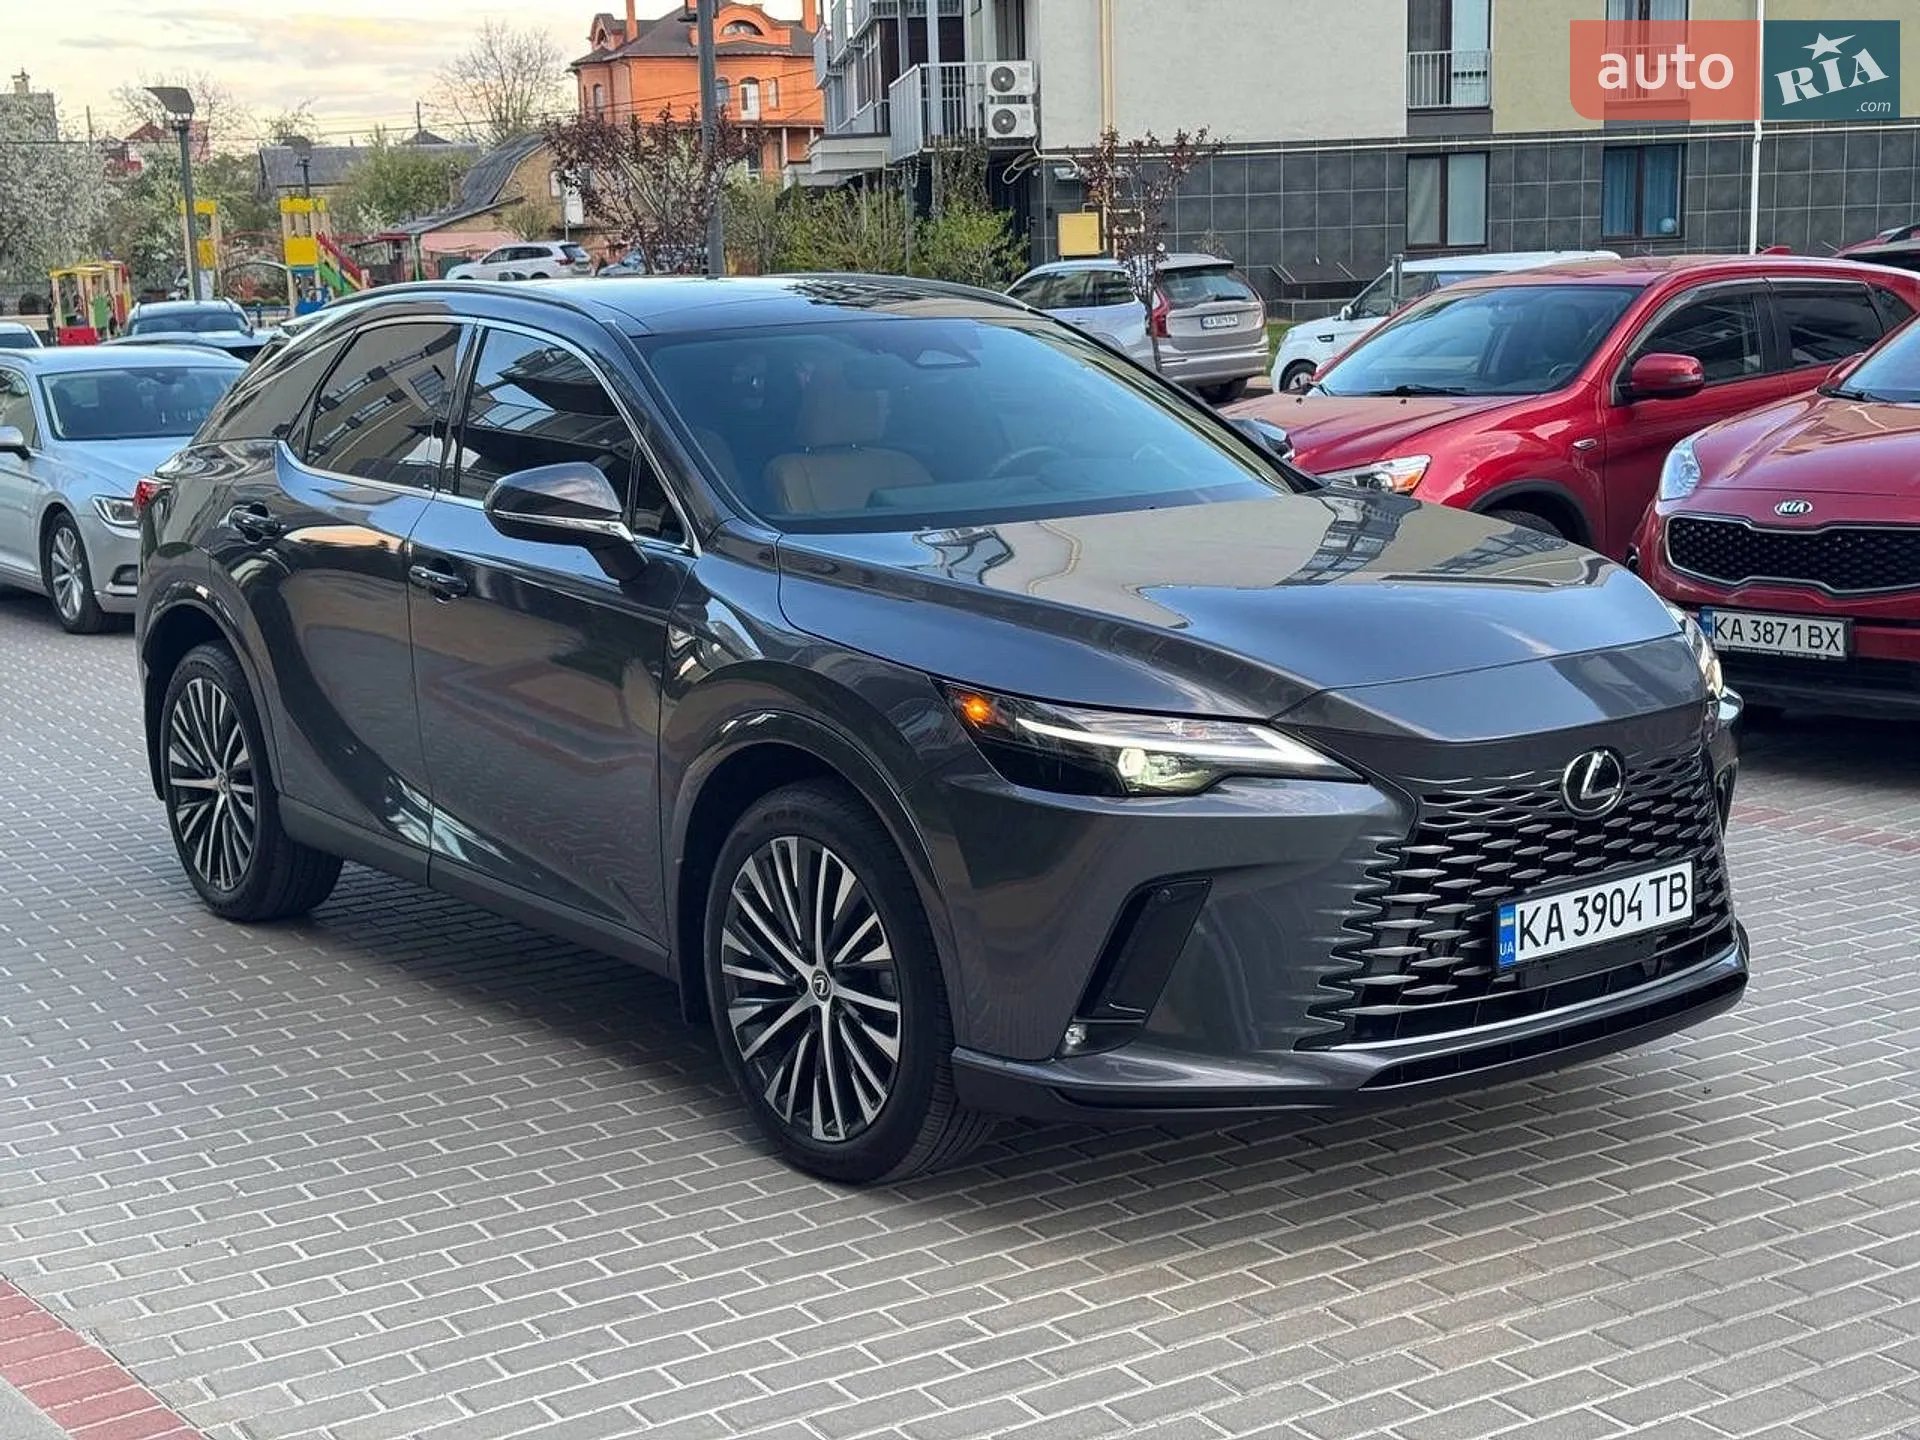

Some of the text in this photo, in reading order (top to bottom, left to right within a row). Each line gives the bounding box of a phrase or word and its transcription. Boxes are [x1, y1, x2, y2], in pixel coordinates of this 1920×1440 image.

[1778, 501, 1807, 513] KIA
[1714, 616, 1840, 652] KA 3871 BX
[1519, 871, 1688, 951] KA 3904 TB
[1500, 943, 1514, 956] UA
